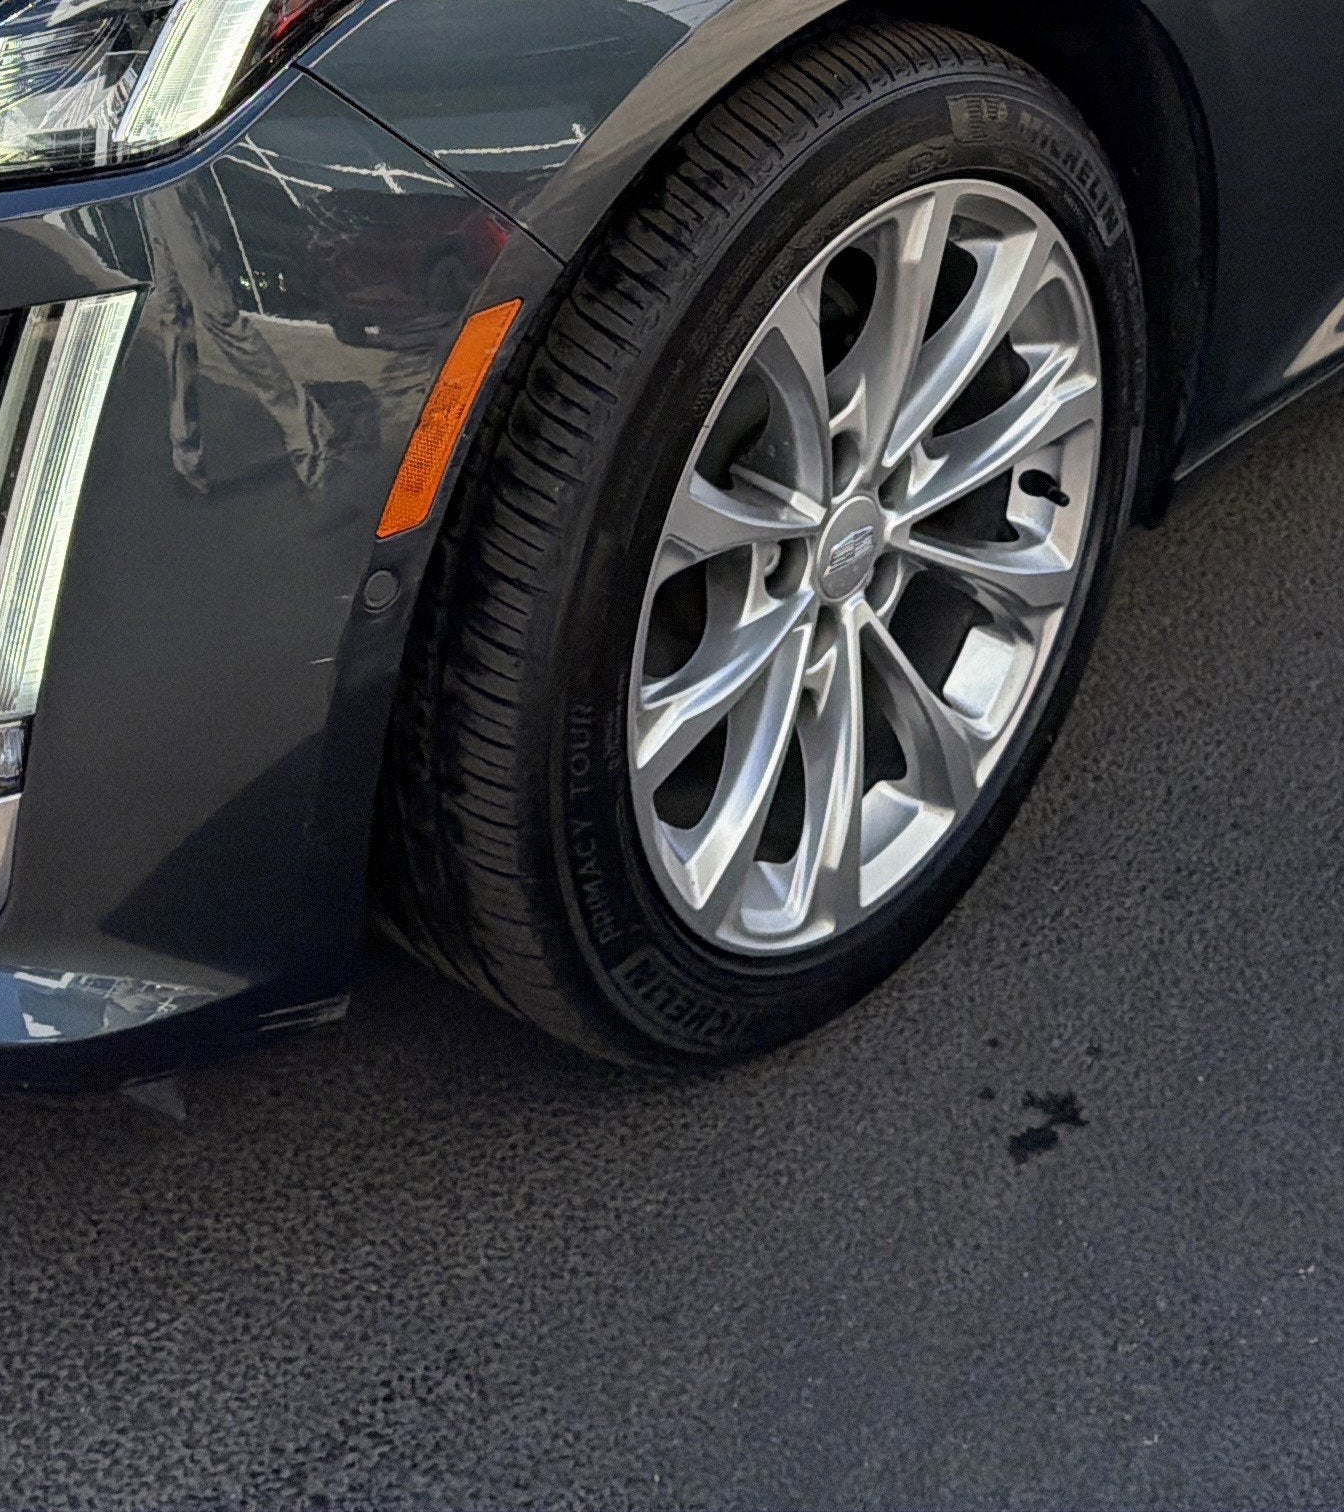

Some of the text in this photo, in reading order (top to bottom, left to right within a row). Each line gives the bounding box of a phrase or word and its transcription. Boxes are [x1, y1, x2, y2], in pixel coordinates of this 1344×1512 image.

[1017, 108, 1126, 240] MICHELIN
[569, 703, 593, 801] TOUR
[570, 818, 623, 945] PRIMACY
